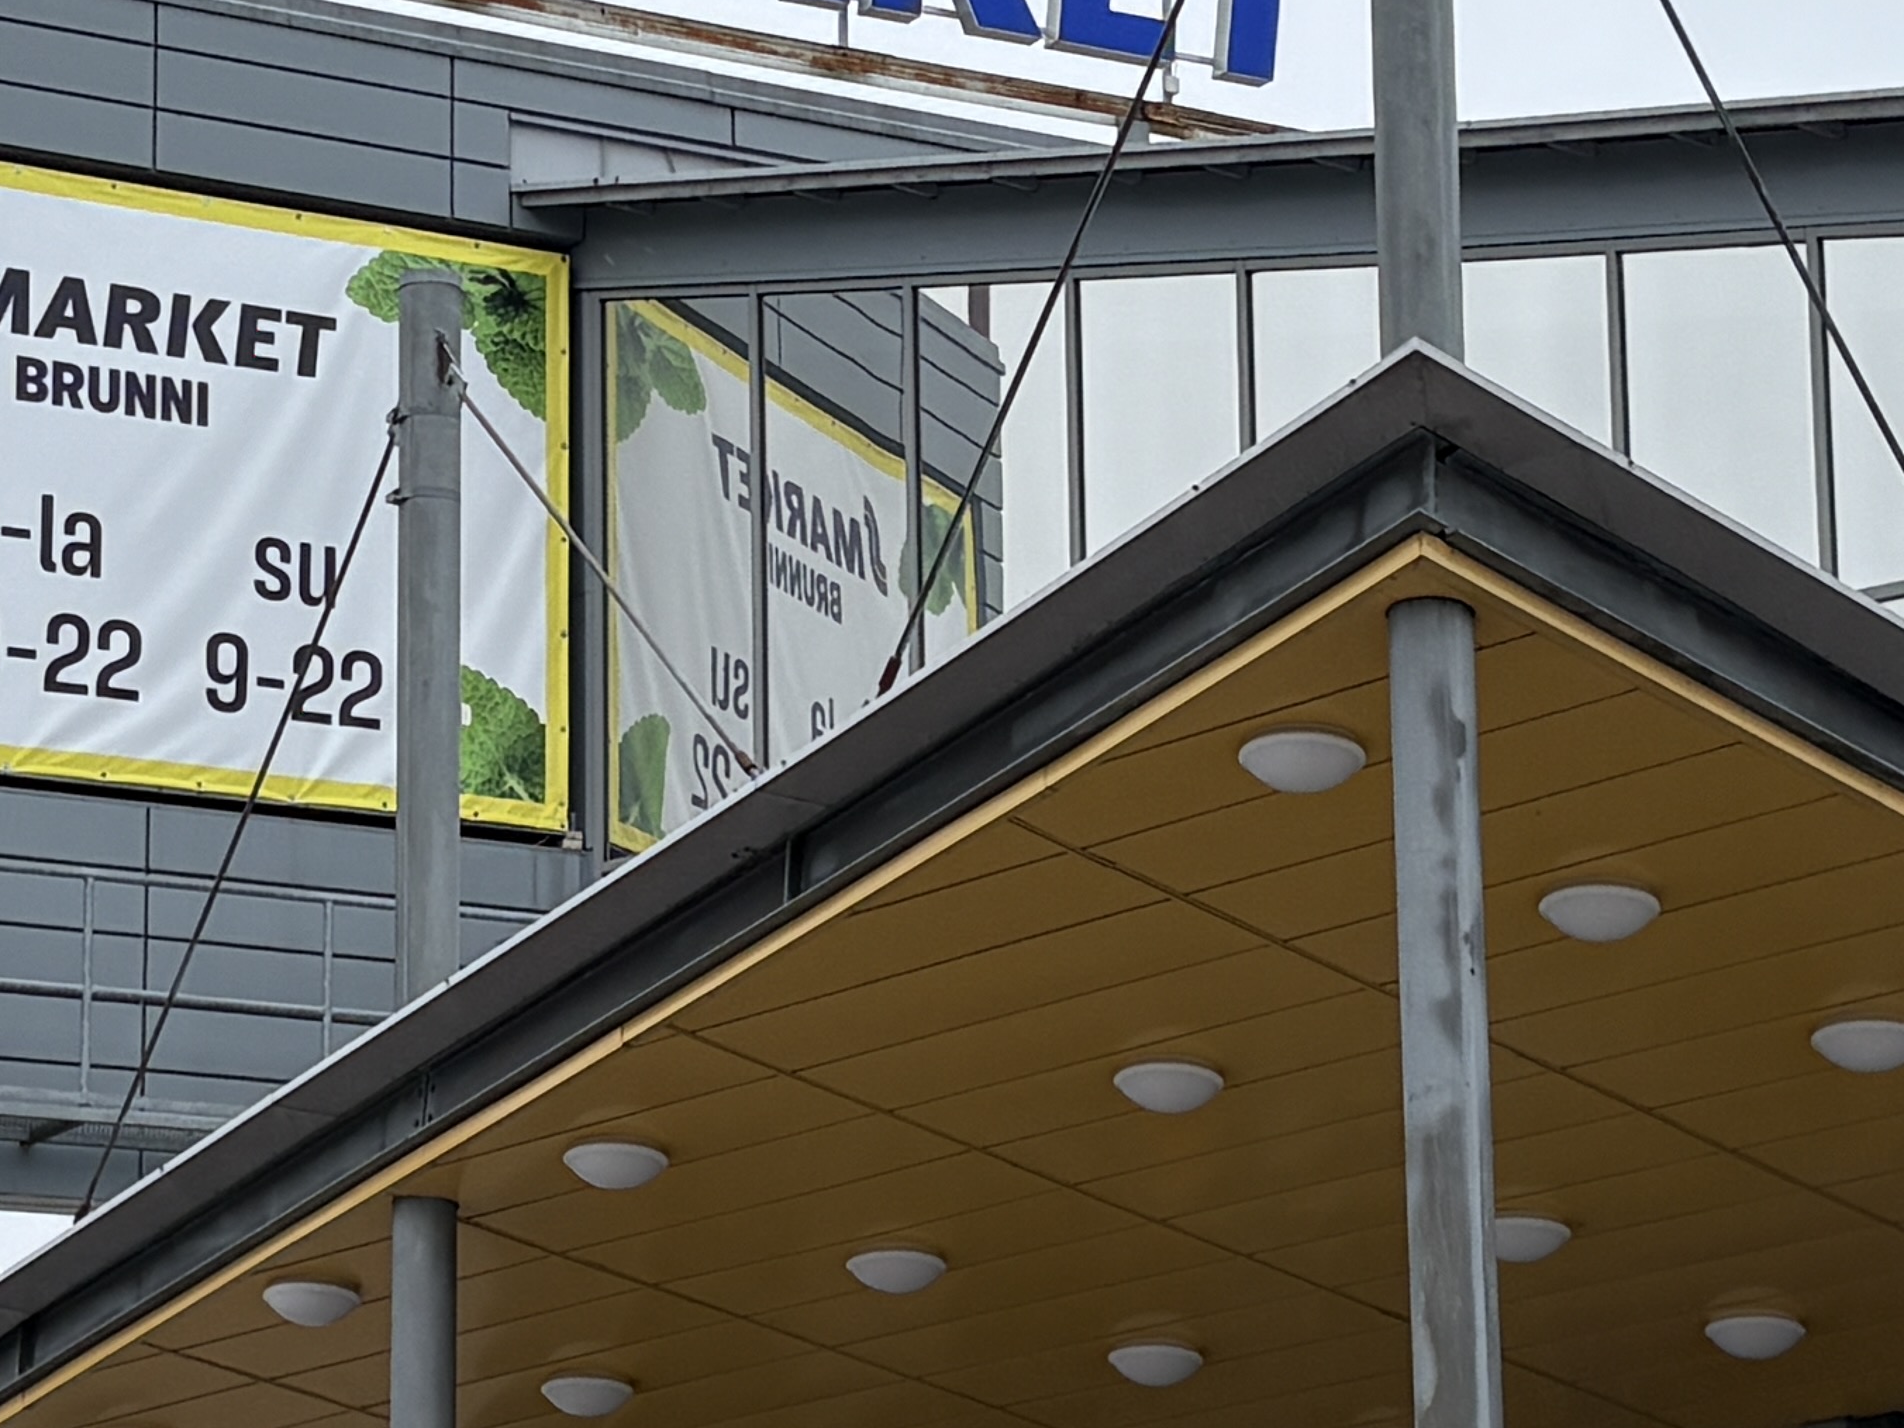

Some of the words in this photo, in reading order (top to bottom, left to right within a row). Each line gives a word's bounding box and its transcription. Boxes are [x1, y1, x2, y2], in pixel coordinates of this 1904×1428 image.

[14, 354, 209, 428] BRUNNI
[252, 534, 337, 609] su
[204, 630, 384, 731] 9-22
